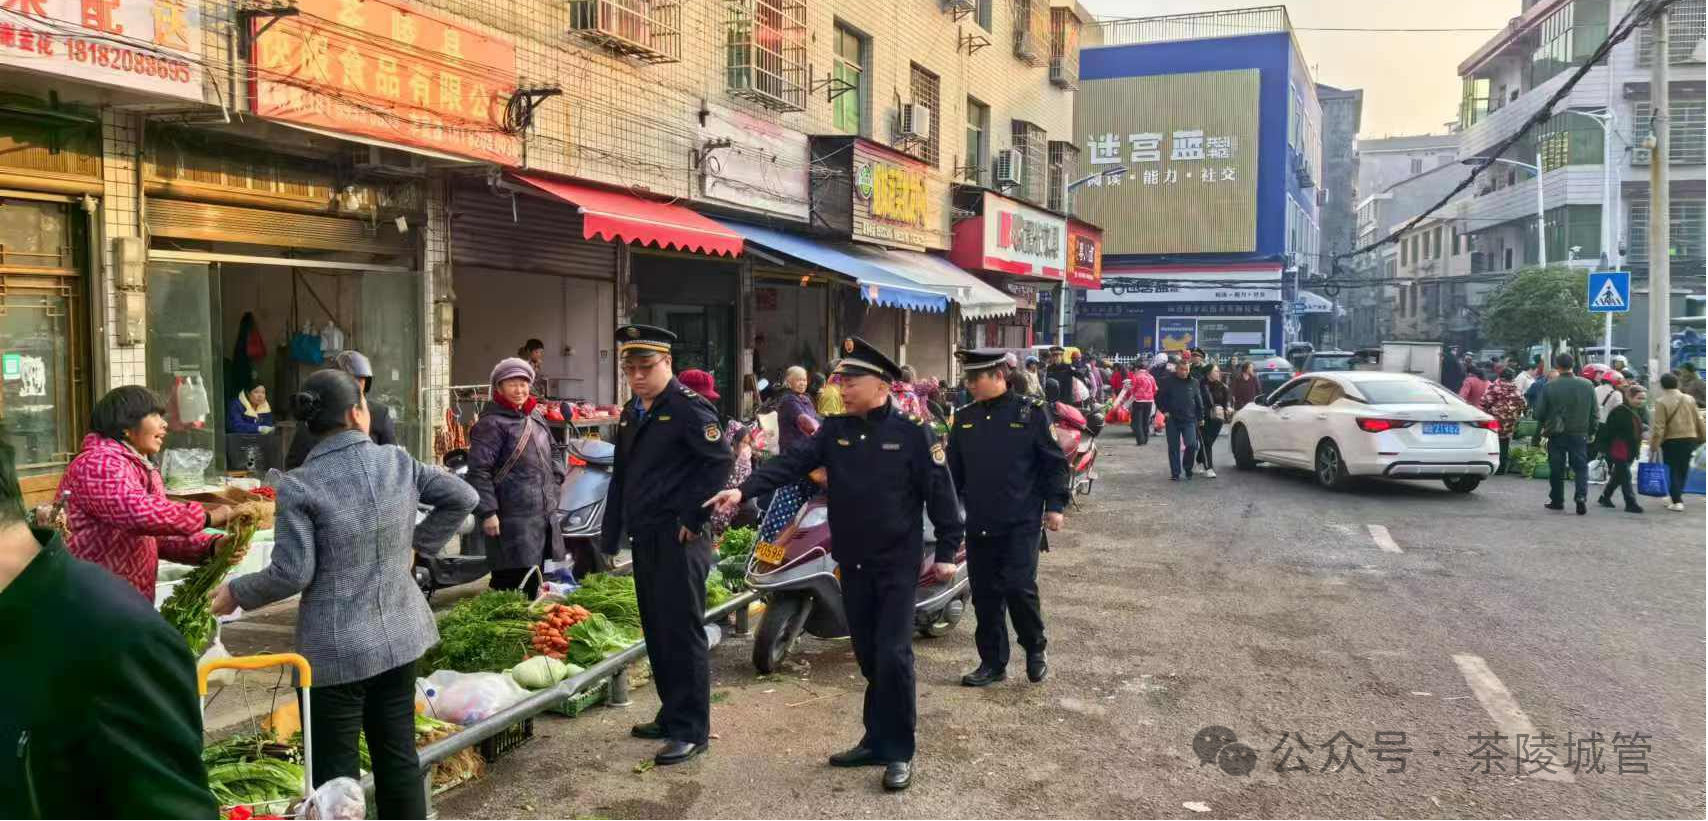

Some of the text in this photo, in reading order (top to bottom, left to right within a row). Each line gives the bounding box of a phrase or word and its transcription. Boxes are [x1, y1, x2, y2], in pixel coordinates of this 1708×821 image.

[64, 37, 191, 84] 18182088695
[1087, 130, 1206, 164] 迷宫蓝
